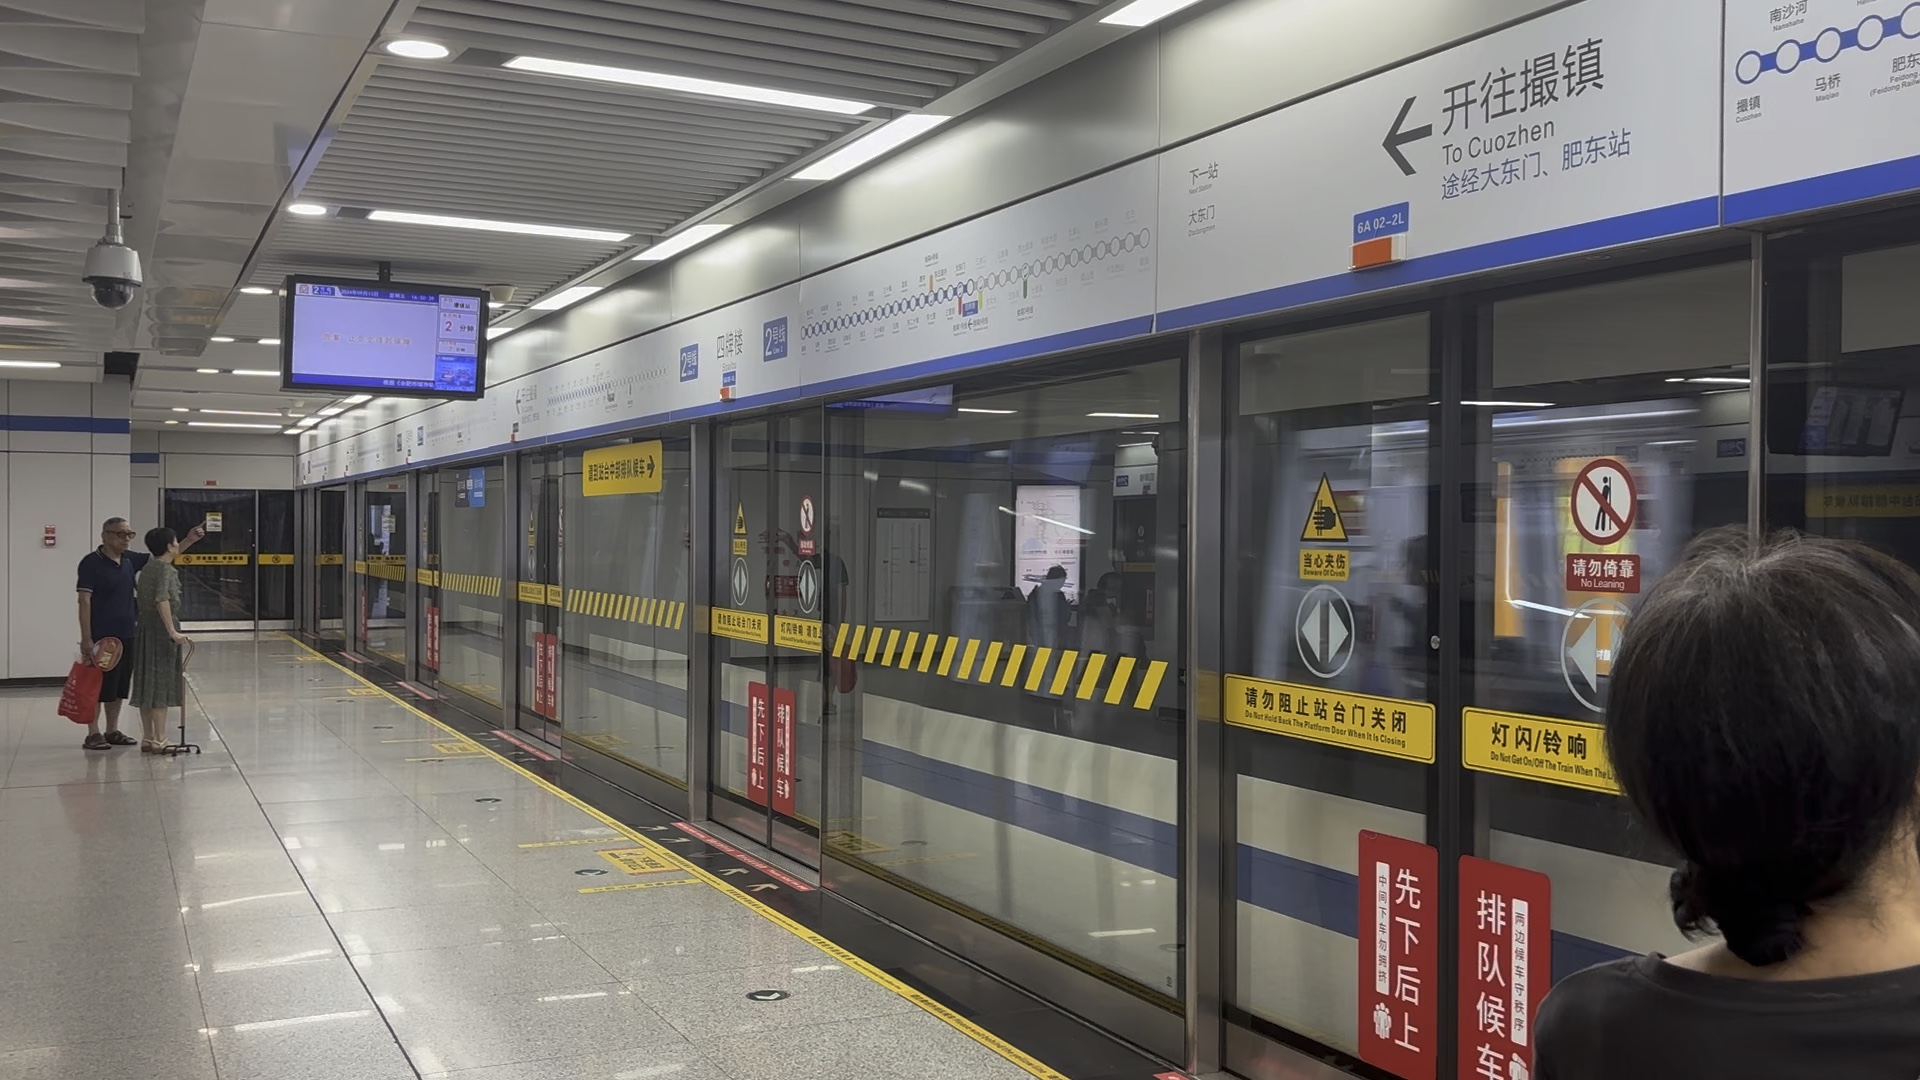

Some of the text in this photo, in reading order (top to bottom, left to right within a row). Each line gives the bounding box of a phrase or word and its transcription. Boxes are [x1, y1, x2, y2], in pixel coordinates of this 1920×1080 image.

[1769, 0, 1808, 24] 南沙河
[1442, 38, 1604, 136] 开往撮镇
[1814, 73, 1841, 92] 马桥
[1736, 95, 1761, 114] 撮镇
[1442, 120, 1555, 166] To Cuozhen
[1189, 161, 1219, 186] 下一站
[1441, 128, 1632, 201] 途经大东门、肥东站
[1188, 204, 1215, 226] 大东门
[1357, 212, 1405, 234] 6A 02-2L
[445, 321, 475, 333] 2 分钟
[765, 324, 786, 357] 2号线
[717, 329, 743, 360] 四牌楼
[682, 349, 697, 378] 2号线
[1303, 552, 1346, 569] 当心夹伤
[1572, 559, 1635, 578] 请勿倚靠
[1580, 578, 1625, 591] No Leaning
[1245, 686, 1407, 734] 请勿阻止站台门关闭
[757, 698, 765, 790] 先下后上
[1245, 710, 1406, 748] Do Not Hold Back The Platform Door When It Is Closing
[1491, 722, 1587, 760] 灯闪/铃响
[777, 703, 785, 798] 排队候车
[1490, 750, 1499, 761] Do
[1500, 752, 1511, 763] Not
[1511, 754, 1523, 765] Get
[1523, 756, 1544, 769] On/Off
[1545, 760, 1557, 770] The
[1558, 761, 1574, 773] Train
[1574, 764, 1593, 776] When
[1594, 767, 1607, 779] The
[1377, 874, 1388, 984] 中间下车勿拥挤
[1394, 867, 1422, 1053] 先下后上
[1513, 911, 1526, 1032] 两边候车守秩序
[1476, 889, 1506, 1080] 排队候车
